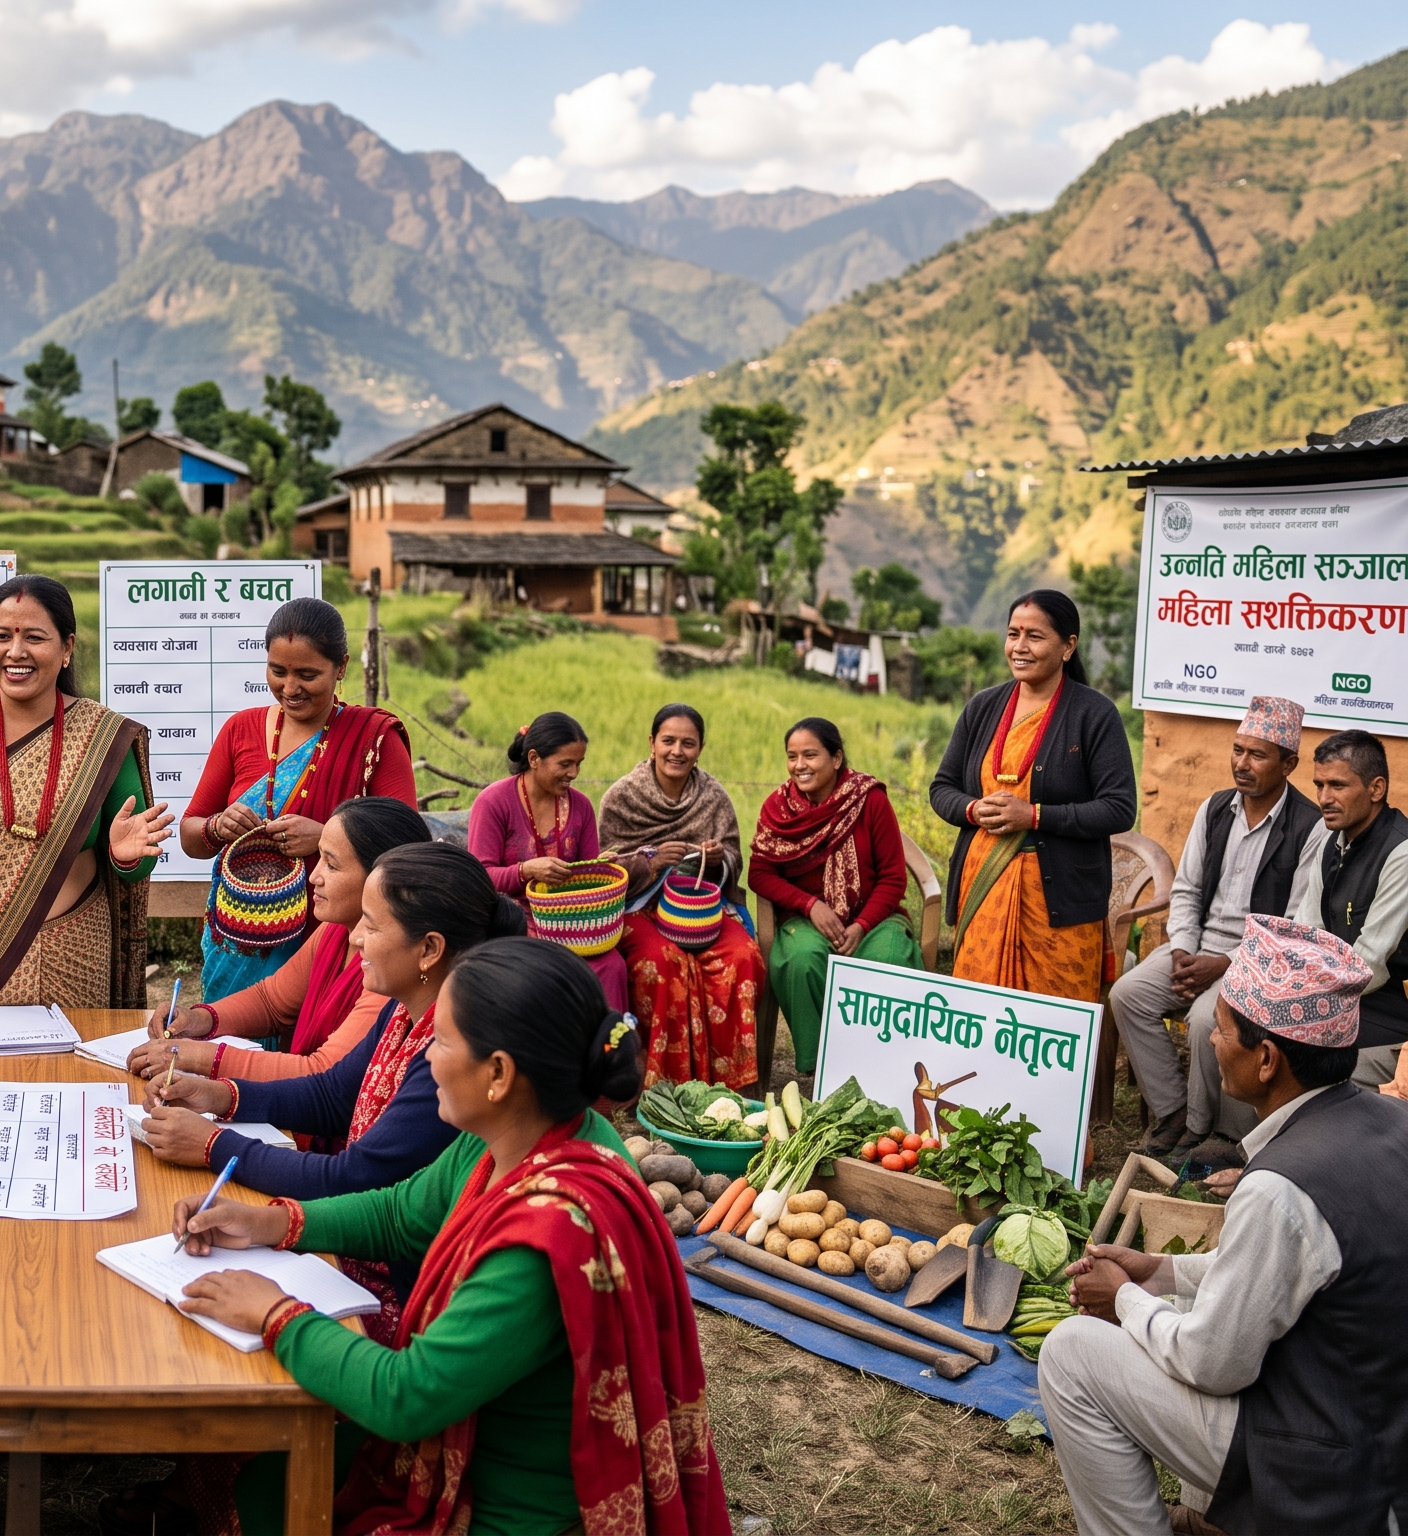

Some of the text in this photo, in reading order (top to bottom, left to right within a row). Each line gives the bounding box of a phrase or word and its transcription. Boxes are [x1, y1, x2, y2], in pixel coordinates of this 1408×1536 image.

[1159, 545, 1408, 581] उन्नति महिला सञ्जाल
[127, 571, 294, 604] लगानी र बचत
[1158, 590, 1408, 635] महिला सशक्तिकरण
[1184, 664, 1217, 680] NGO
[1335, 676, 1368, 690] NGO
[838, 986, 1081, 1077] सामुदायिक नेतृत्व
